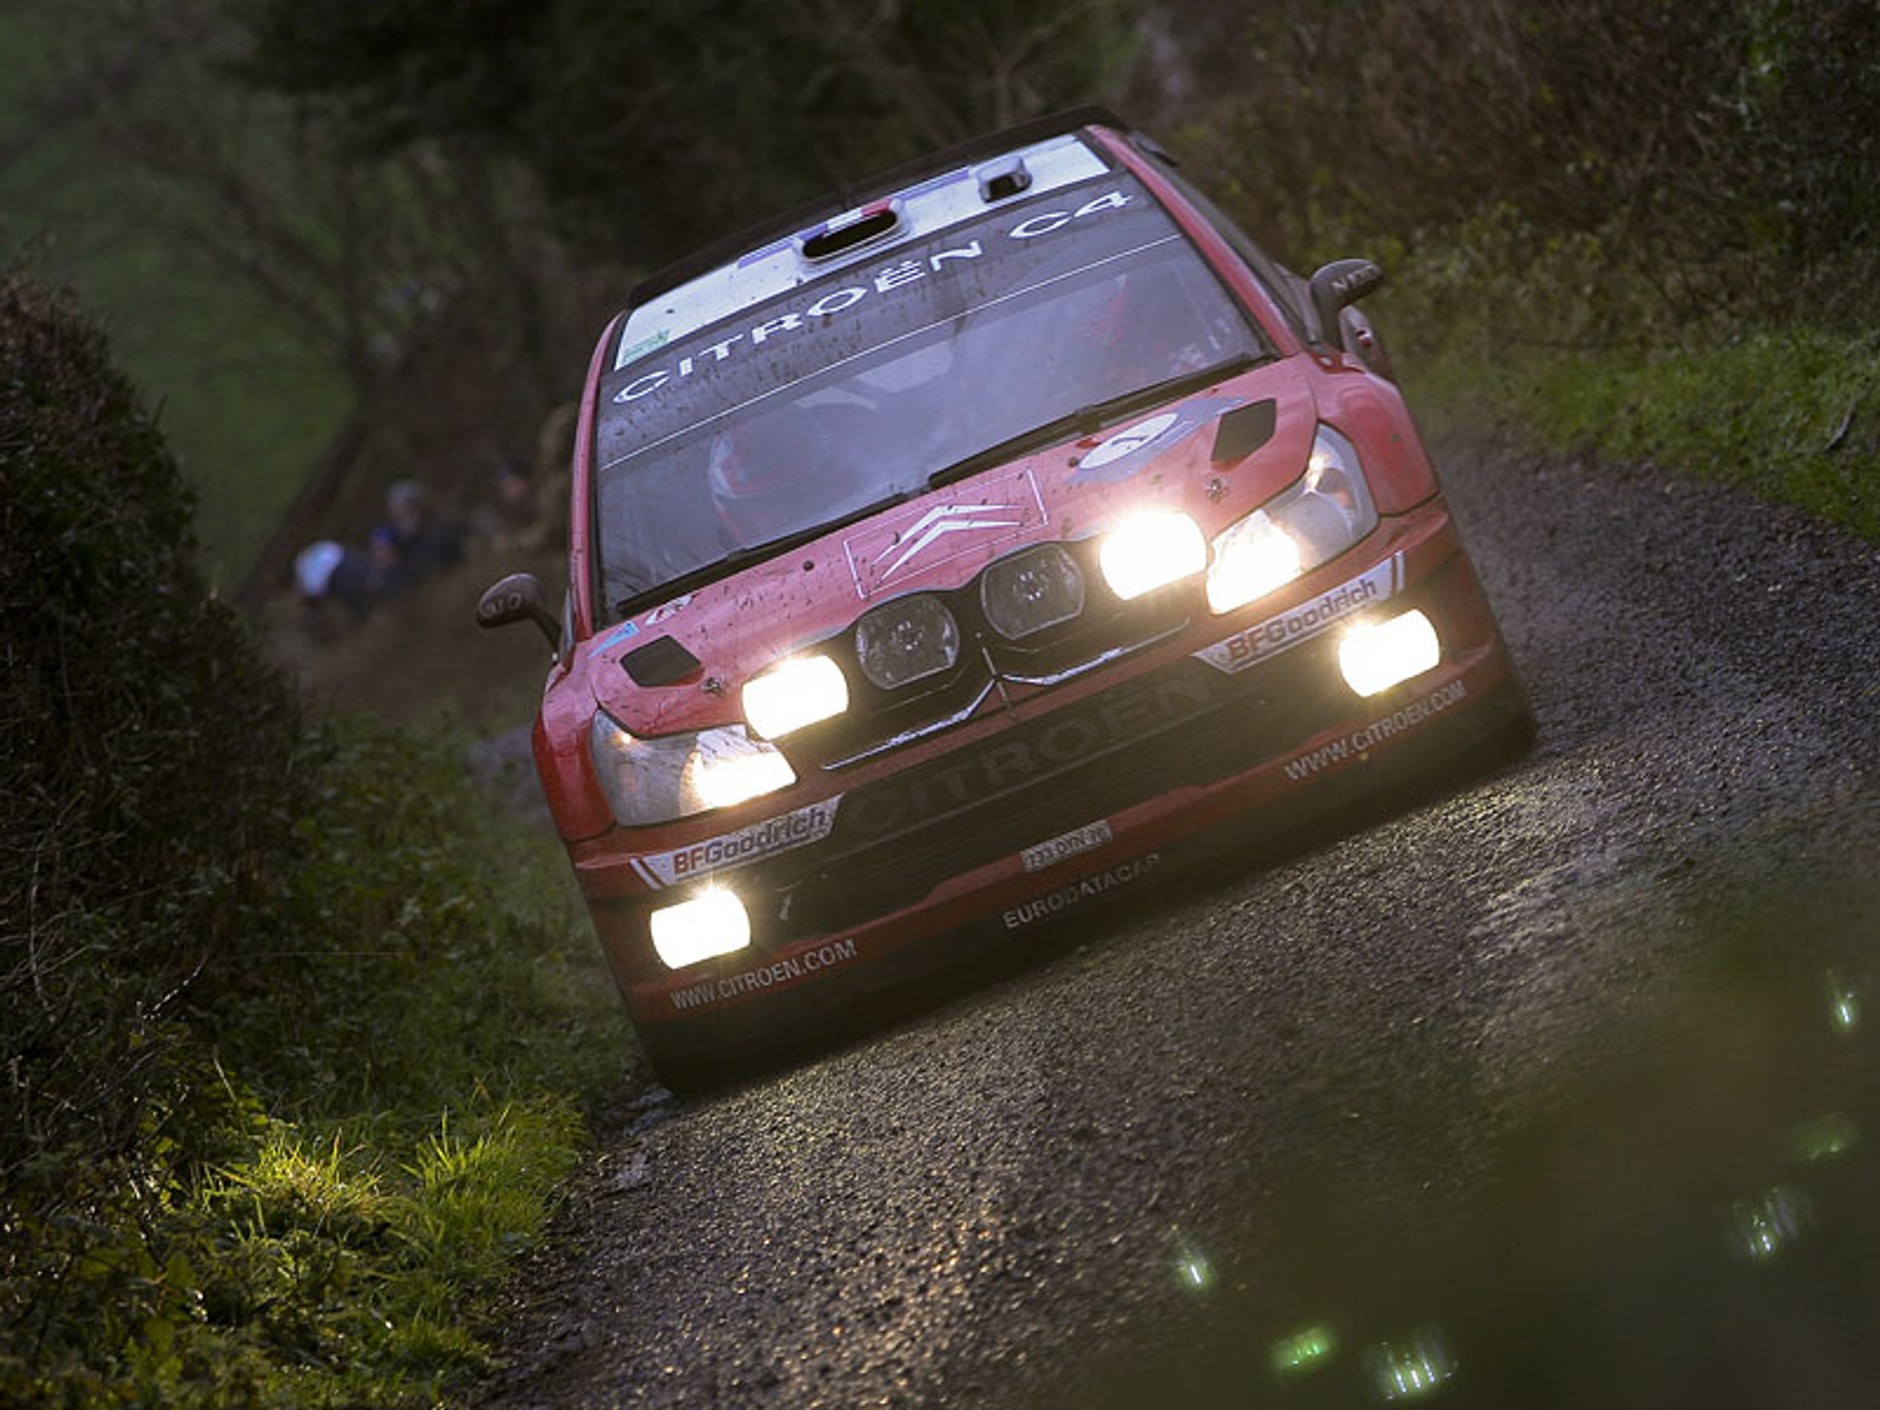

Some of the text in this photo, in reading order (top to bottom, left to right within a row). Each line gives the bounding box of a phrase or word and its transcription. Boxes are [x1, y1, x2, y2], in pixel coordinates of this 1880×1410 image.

[613, 190, 1134, 403] CITROËN C4
[1226, 577, 1378, 661] BFGoodrich
[671, 806, 829, 876] BFGoodrich
[1002, 853, 1161, 929] EURODATACAR
